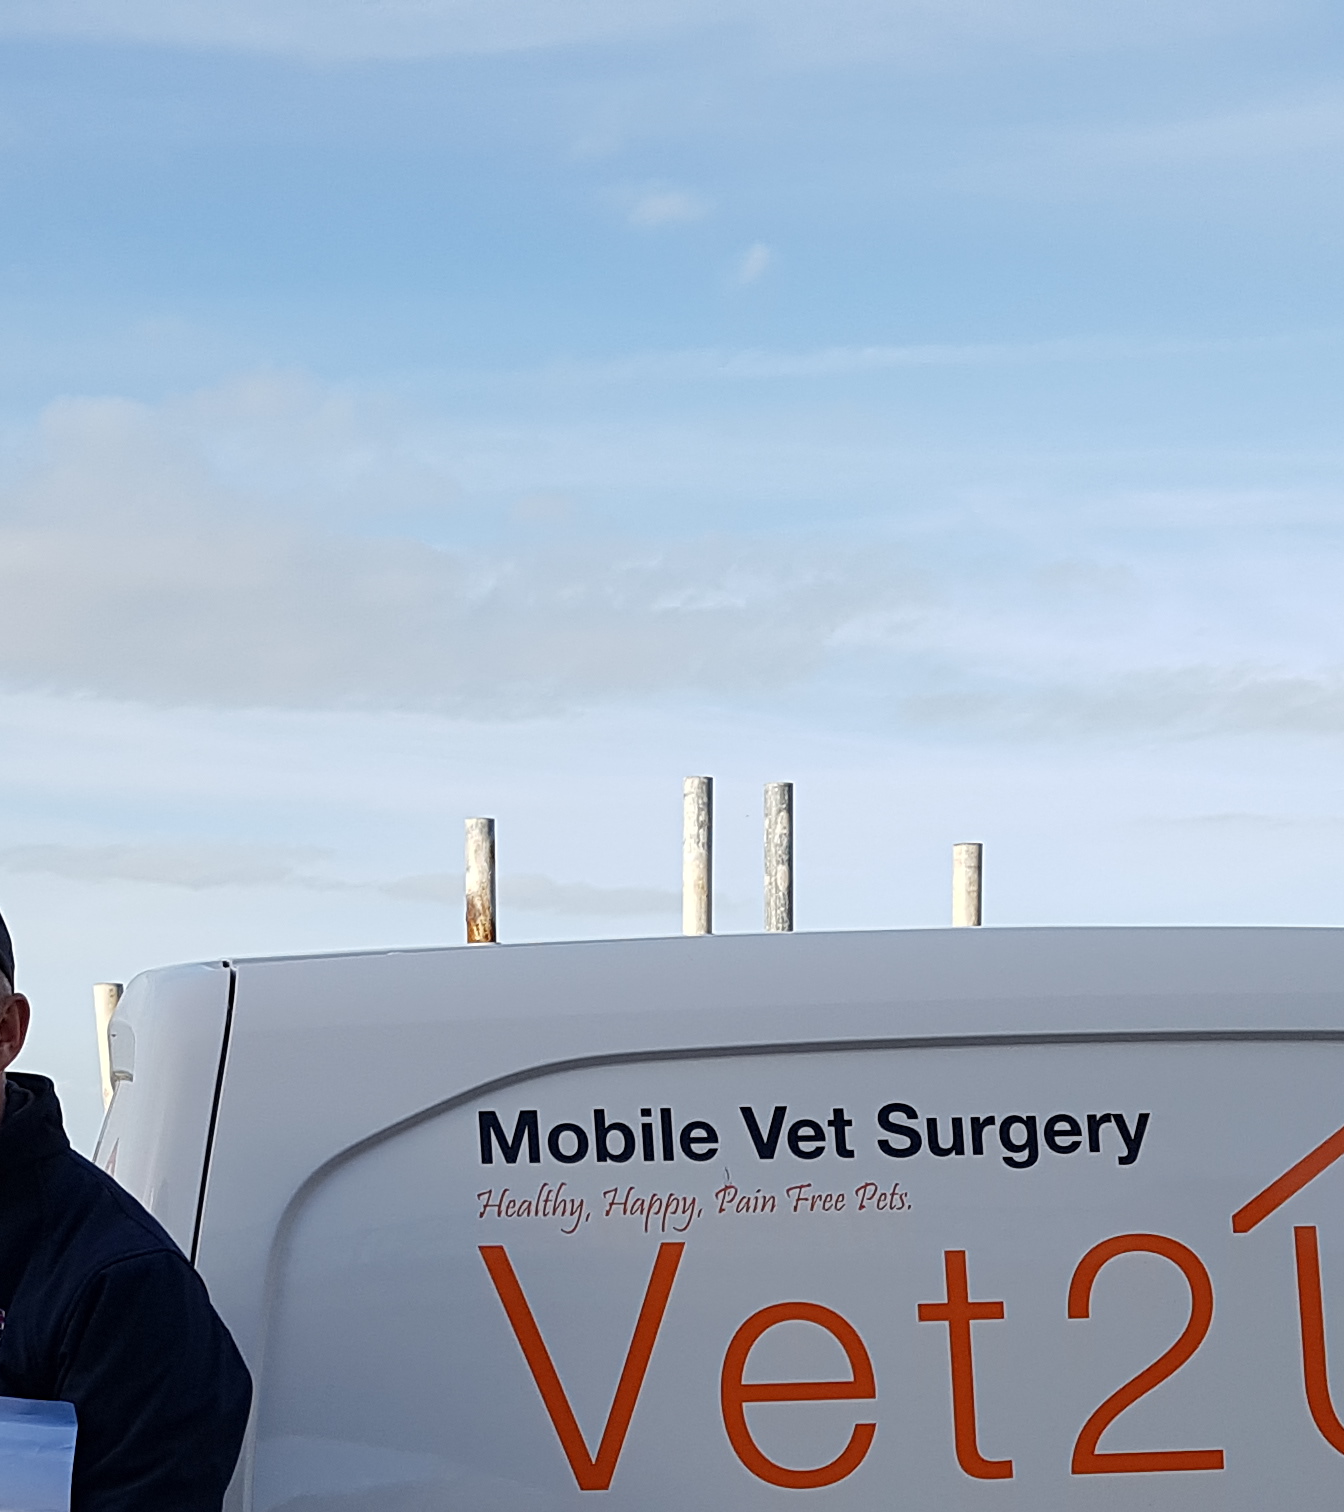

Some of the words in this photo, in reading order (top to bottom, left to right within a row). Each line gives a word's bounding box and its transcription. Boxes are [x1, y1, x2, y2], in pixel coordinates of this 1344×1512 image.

[478, 1107, 719, 1164] Mobile
[739, 1106, 856, 1160] Vet
[877, 1102, 1151, 1169] Surgery
[476, 1182, 591, 1234] Healthy,
[602, 1185, 702, 1232] Happy,
[715, 1182, 777, 1215] Pain
[785, 1182, 846, 1212] Free
[854, 1181, 913, 1212] Pets.
